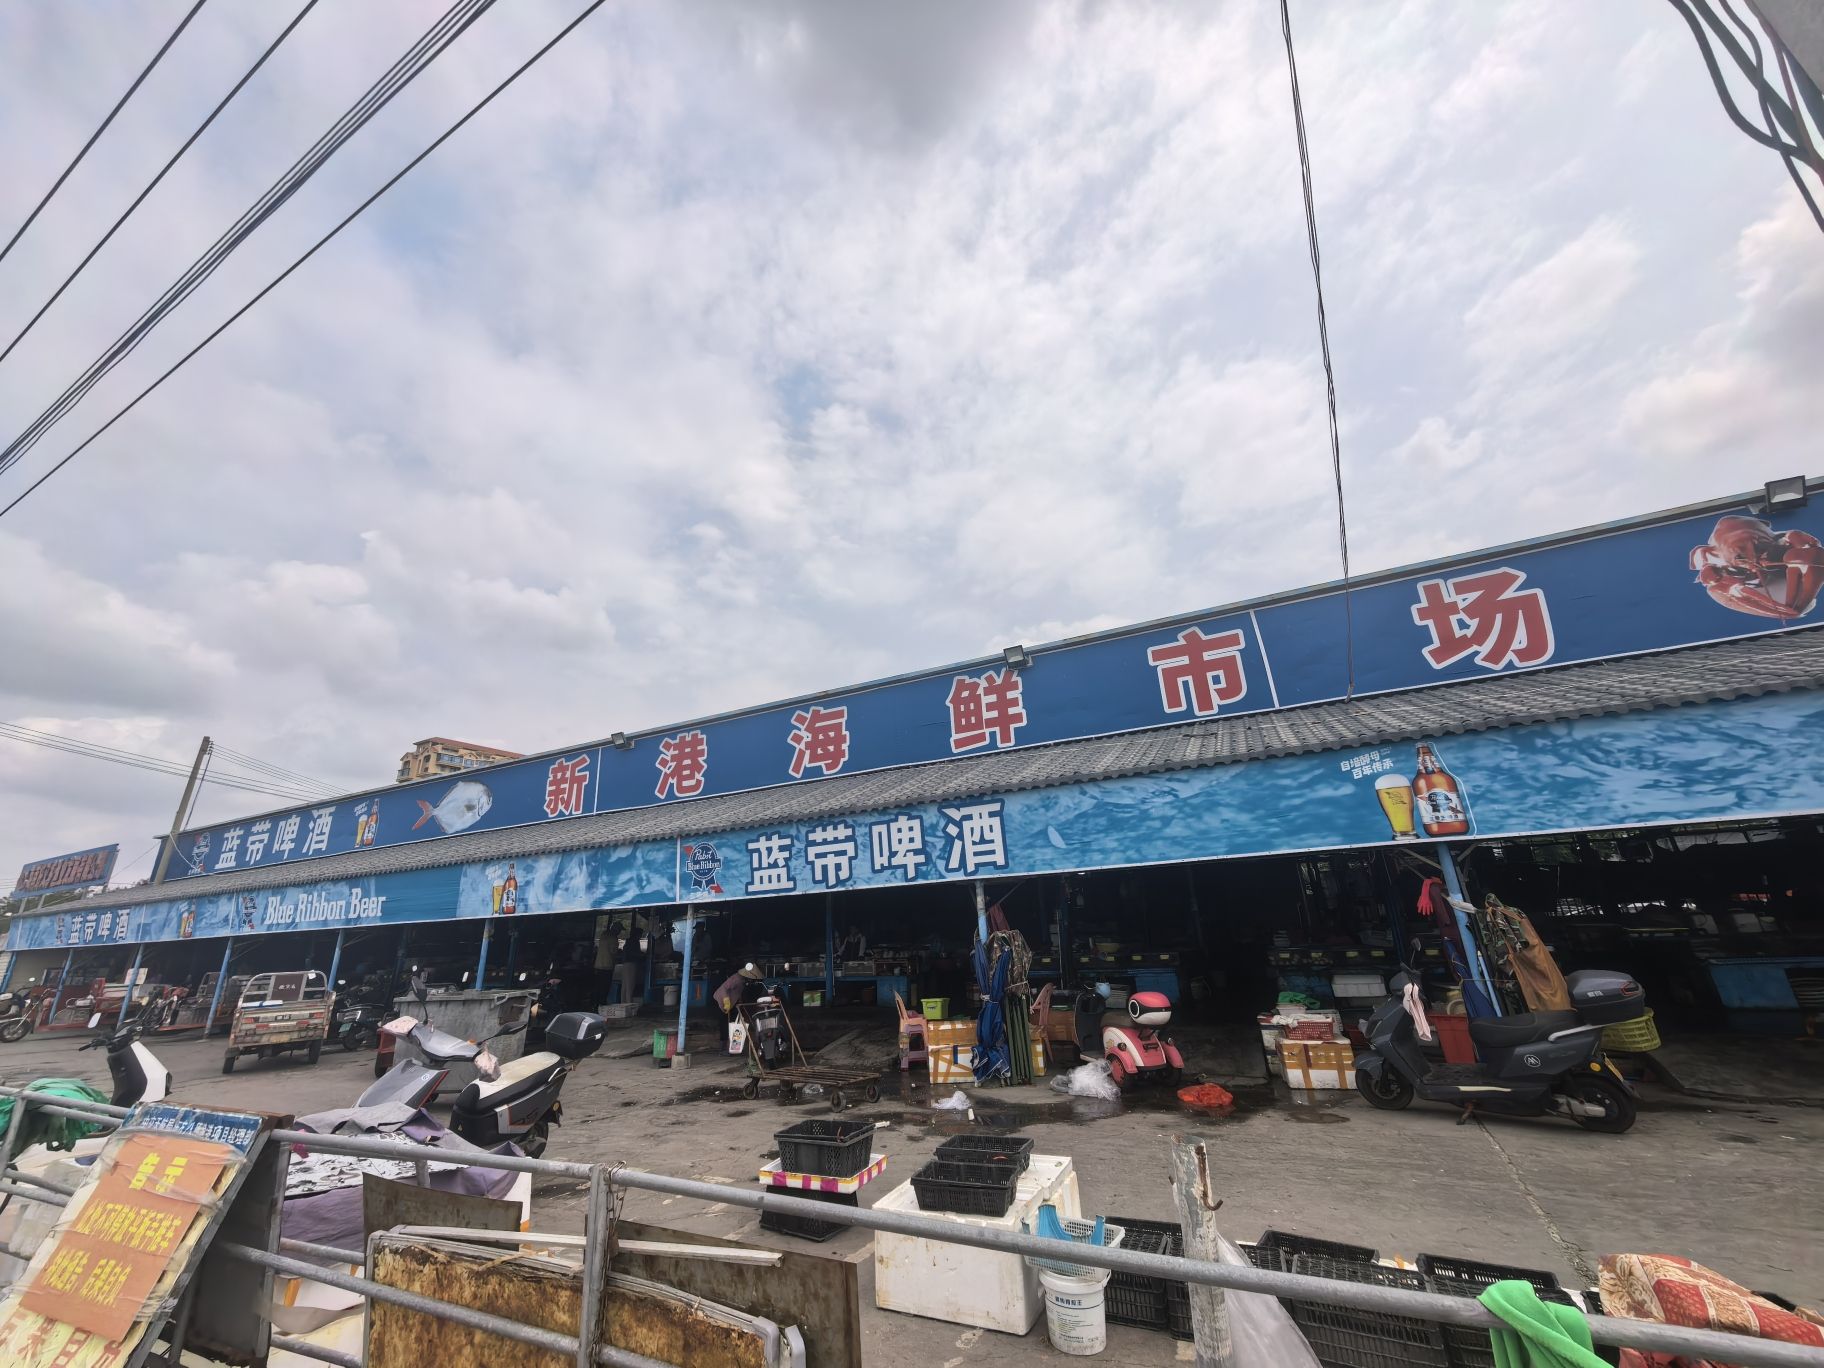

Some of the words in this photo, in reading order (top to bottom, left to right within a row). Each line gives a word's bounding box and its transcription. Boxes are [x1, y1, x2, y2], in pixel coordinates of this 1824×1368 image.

[544, 567, 1555, 817] 新港海鲜市场
[1352, 758, 1394, 779] 百年传承
[214, 806, 336, 870] 蓝带啤酒
[746, 800, 1008, 895] 蓝带啤酒
[68, 908, 131, 944] 蓝带啤酒
[264, 896, 295, 924] Blue
[296, 891, 346, 922] Ribbon
[348, 887, 387, 919] Beer
